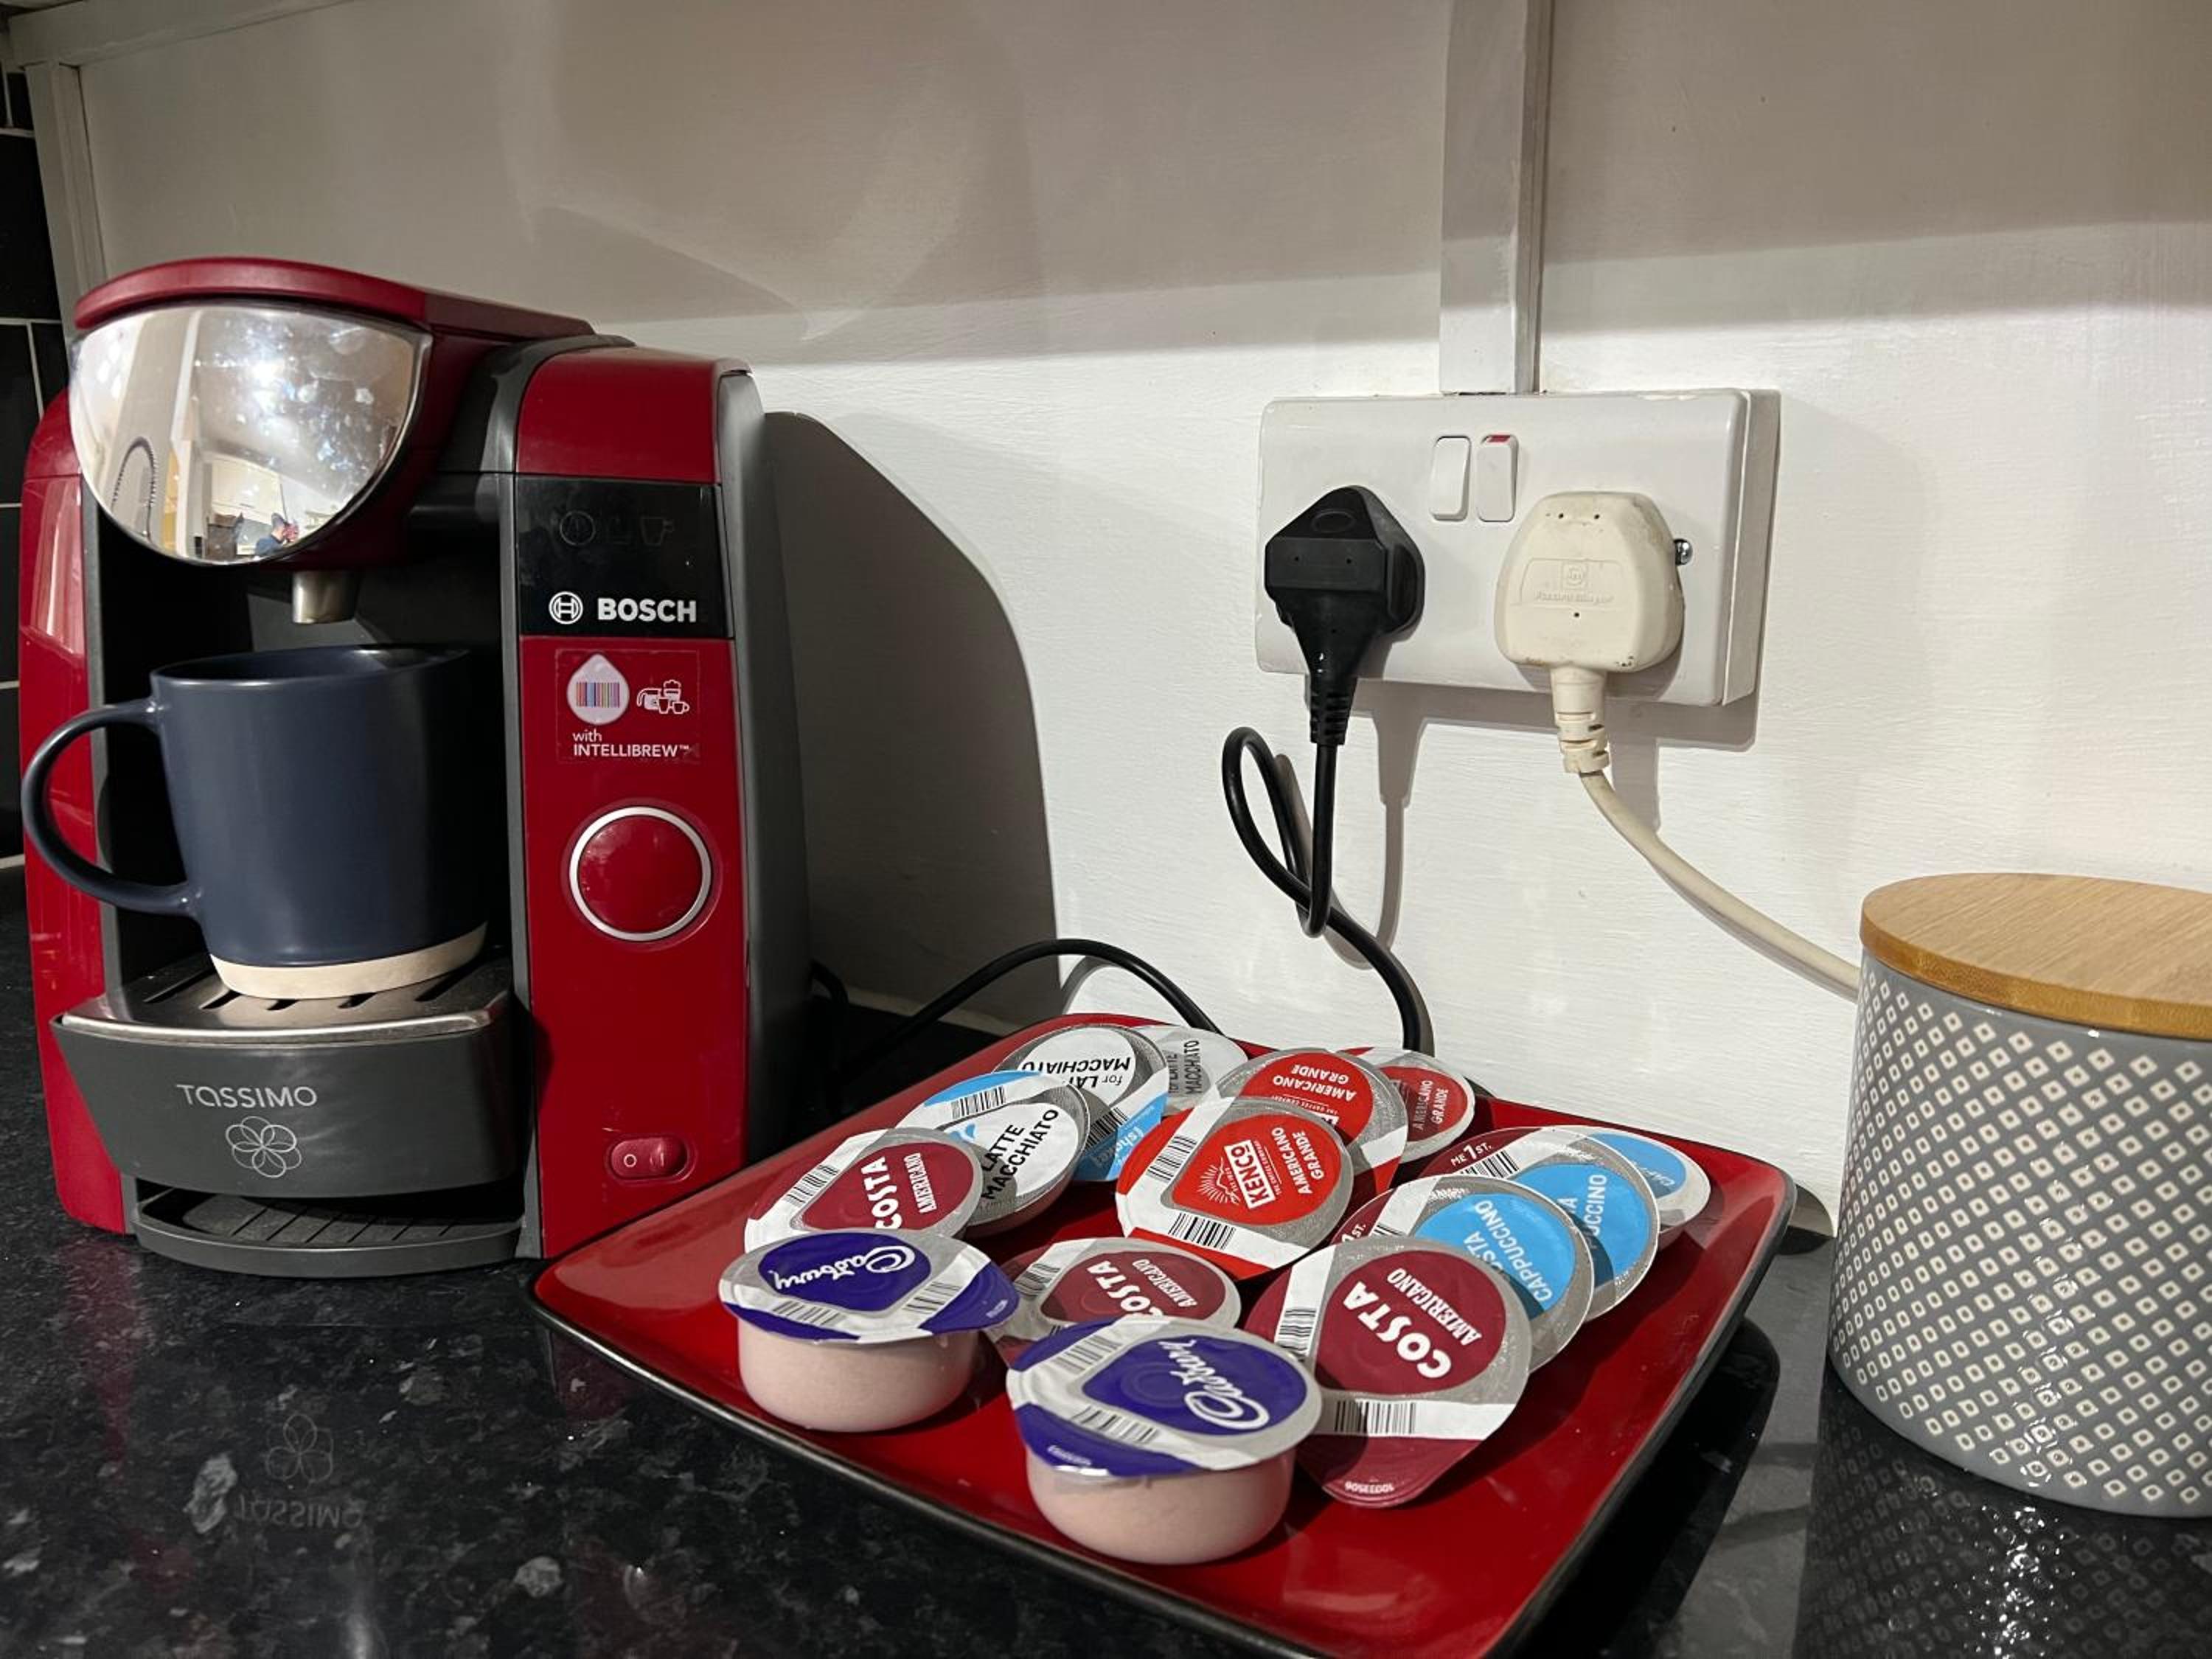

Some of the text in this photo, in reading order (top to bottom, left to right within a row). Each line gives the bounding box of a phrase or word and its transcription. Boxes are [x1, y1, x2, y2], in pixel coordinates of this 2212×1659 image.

[597, 597, 697, 622] BOSCH
[572, 728, 602, 742] with
[176, 1084, 318, 1108] TASSIMO
[1102, 1075, 1123, 1086] for
[1273, 1075, 1357, 1102] AMERICANO
[1292, 1064, 1349, 1084] GRANDE
[1430, 1088, 1449, 1124] GRANDE
[981, 1125, 1025, 1172] LATTE
[981, 1109, 1059, 1200] MACCHIATO
[1271, 1127, 1312, 1194] AMERICANO
[1292, 1130, 1324, 1180] GRANDE
[1450, 1153, 1467, 1166] ME
[861, 1156, 902, 1229] COSTA
[903, 1152, 937, 1214] AMERICANO
[1231, 1144, 1270, 1204] KENCO
[768, 1245, 915, 1290] Cadbury
[1474, 1200, 1553, 1302] CAPPUCCINO
[1133, 1259, 1197, 1307] AMERICANO
[1387, 1267, 1482, 1346] AMERICANO
[1343, 1281, 1451, 1378] COSTA
[1158, 1339, 1270, 1429] Cadbury
